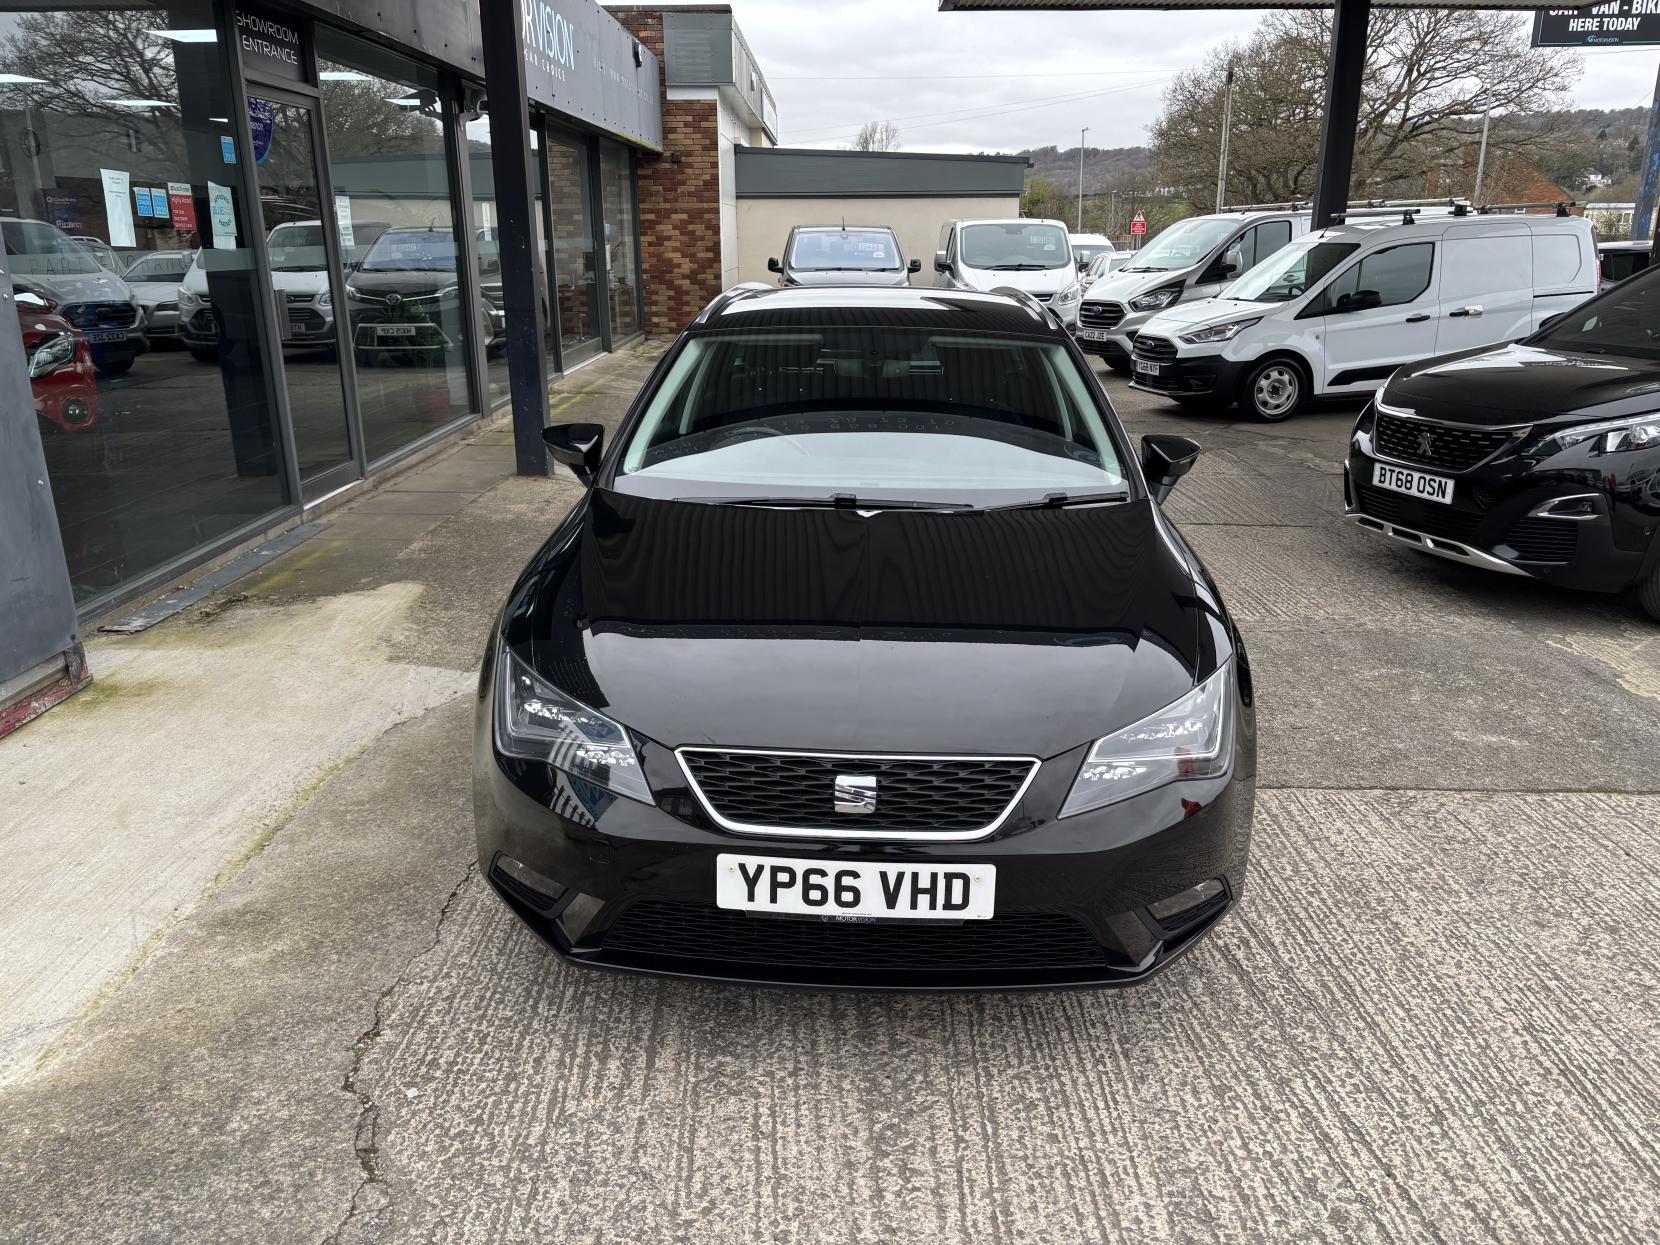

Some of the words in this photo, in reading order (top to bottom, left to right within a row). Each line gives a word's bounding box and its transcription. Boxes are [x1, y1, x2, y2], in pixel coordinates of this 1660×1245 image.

[236, 10, 299, 45] SHOWROOM
[1569, 18, 1600, 31] HERE
[1602, 17, 1640, 31] TODAY
[242, 35, 298, 65] ENTRANCE
[542, 59, 565, 81] CHOICE
[1379, 466, 1413, 490] BT68
[1417, 476, 1447, 499] OSN
[738, 862, 861, 908] YP66
[879, 870, 971, 912] VHD
